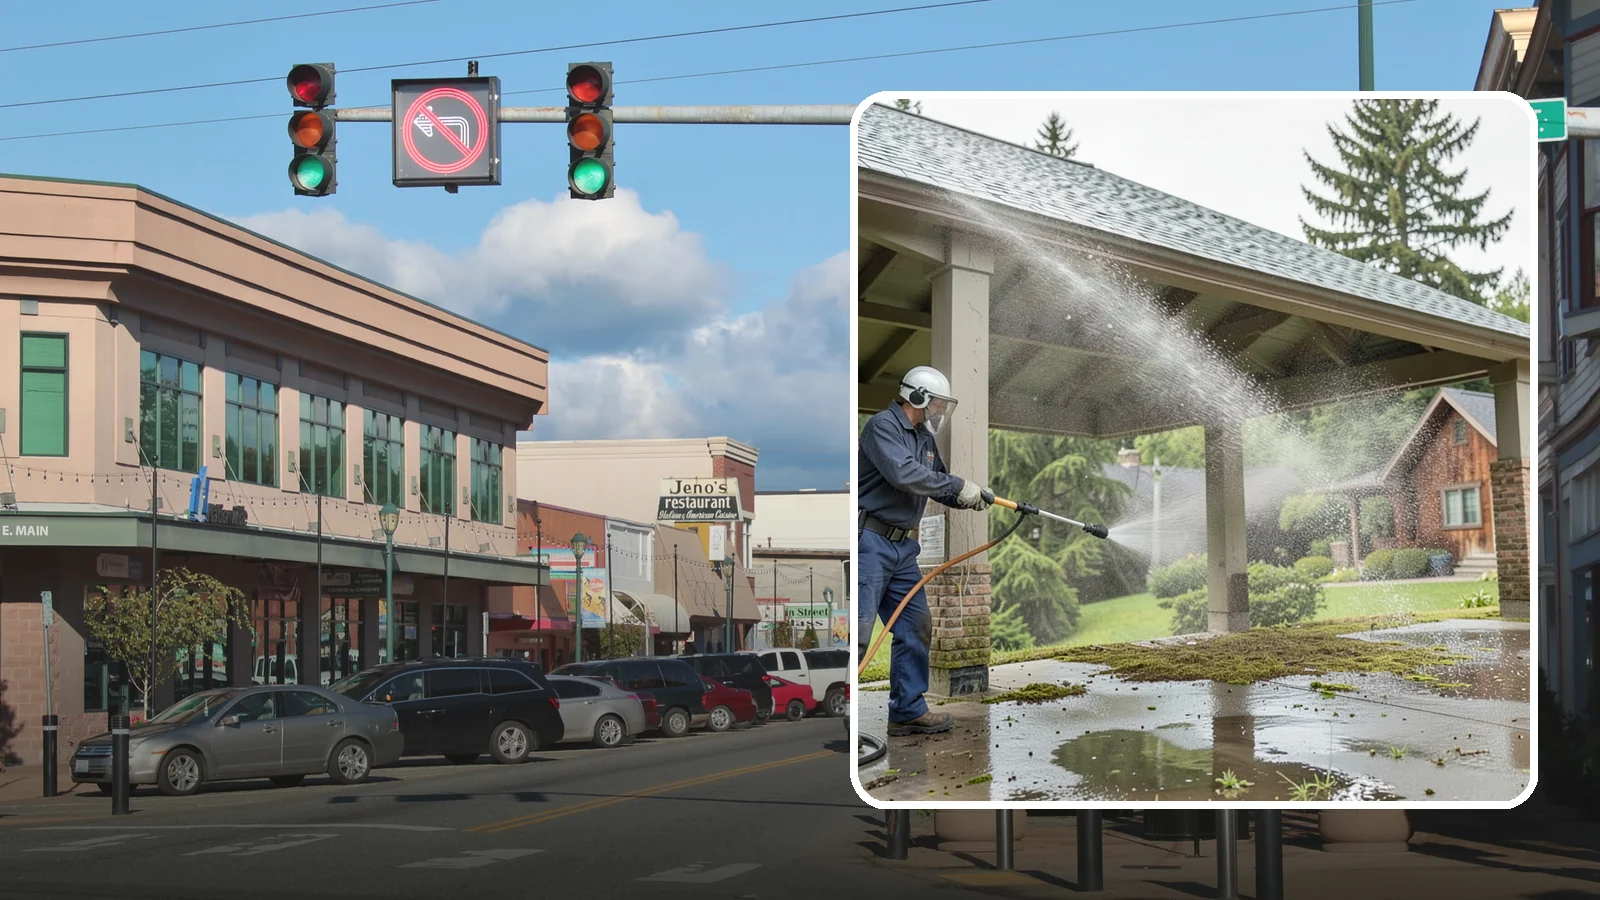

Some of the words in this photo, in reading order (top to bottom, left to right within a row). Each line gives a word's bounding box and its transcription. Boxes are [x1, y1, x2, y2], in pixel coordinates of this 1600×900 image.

[669, 480, 728, 495] Jeno's
[665, 496, 731, 509] restaurant
[658, 510, 681, 519] Italian
[686, 510, 714, 519] American
[715, 510, 738, 519] Cuisine
[2, 525, 13, 536] E.
[15, 525, 49, 536] MAIN
[786, 607, 795, 617] in
[797, 607, 828, 617] Street
